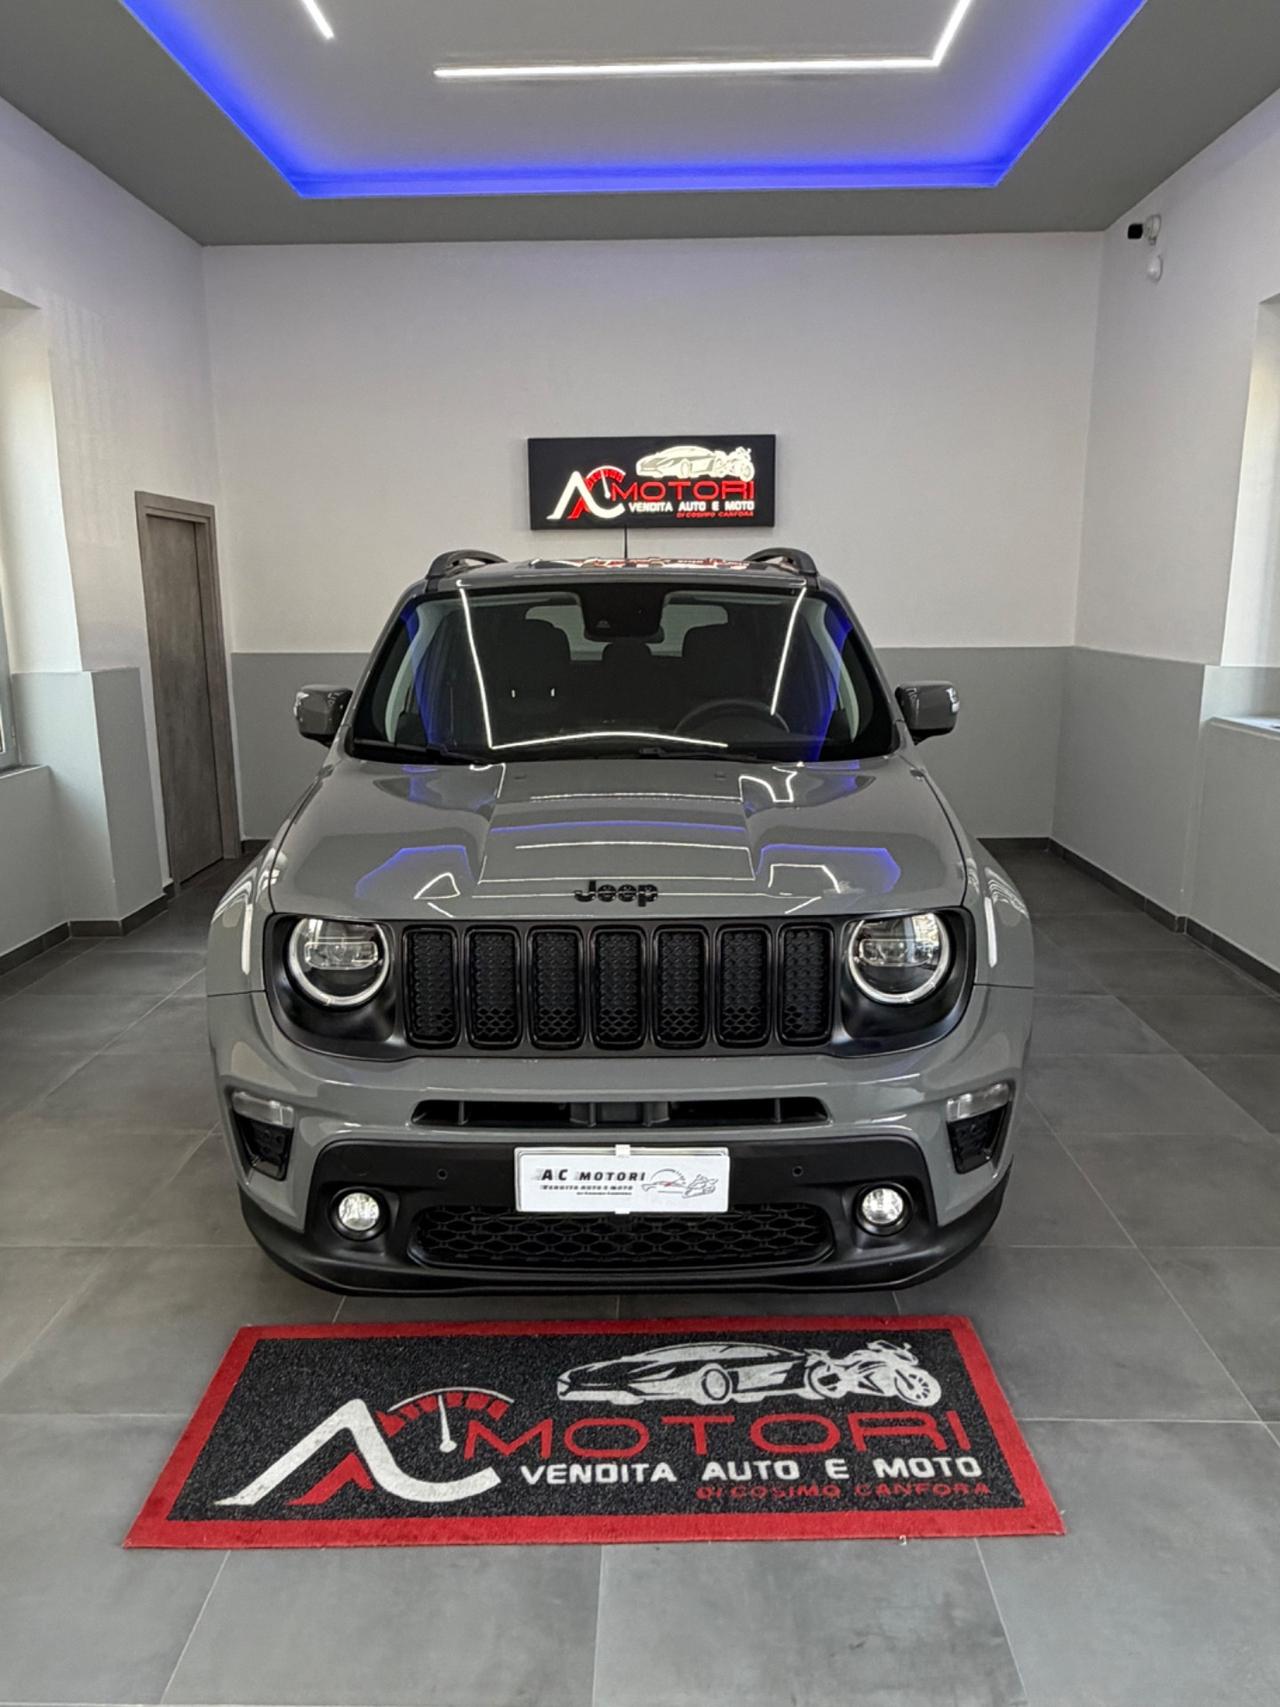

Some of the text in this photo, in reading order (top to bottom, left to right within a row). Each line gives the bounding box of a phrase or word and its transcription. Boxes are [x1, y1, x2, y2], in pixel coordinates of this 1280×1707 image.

[611, 480, 755, 501] MOTORI
[628, 500, 755, 513] VENDITA AUTO E MOTO
[573, 880, 658, 907] Jeep
[578, 1171, 646, 1181] MOTORI
[463, 1410, 972, 1460] MOTORI
[520, 1456, 983, 1486] VENDITA AUTO E MOTO
[695, 1482, 991, 1500] DI COSIMO CANFORA
